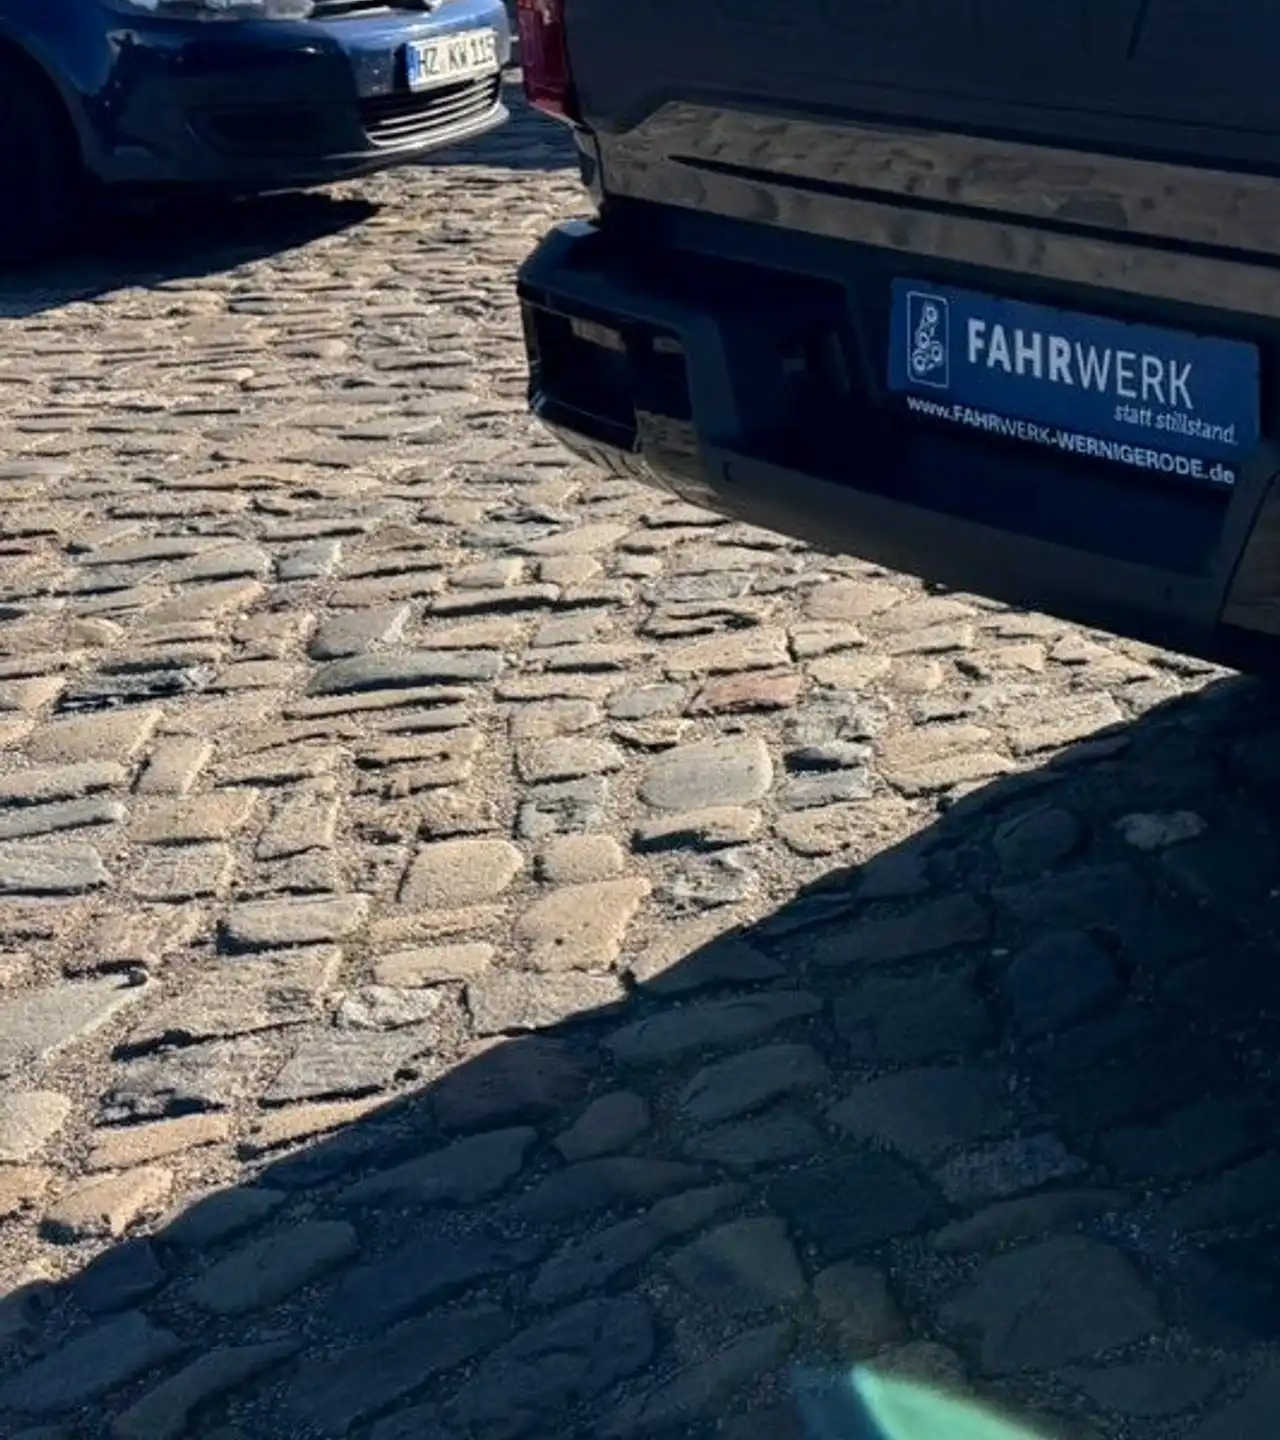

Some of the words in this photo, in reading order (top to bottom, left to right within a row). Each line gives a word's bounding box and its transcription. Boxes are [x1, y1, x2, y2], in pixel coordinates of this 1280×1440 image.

[966, 317, 1194, 410] FAHRWERK
[906, 394, 1236, 485] www.FAHRWERK-WERNIGERODE.de
[1113, 402, 1151, 427] statt
